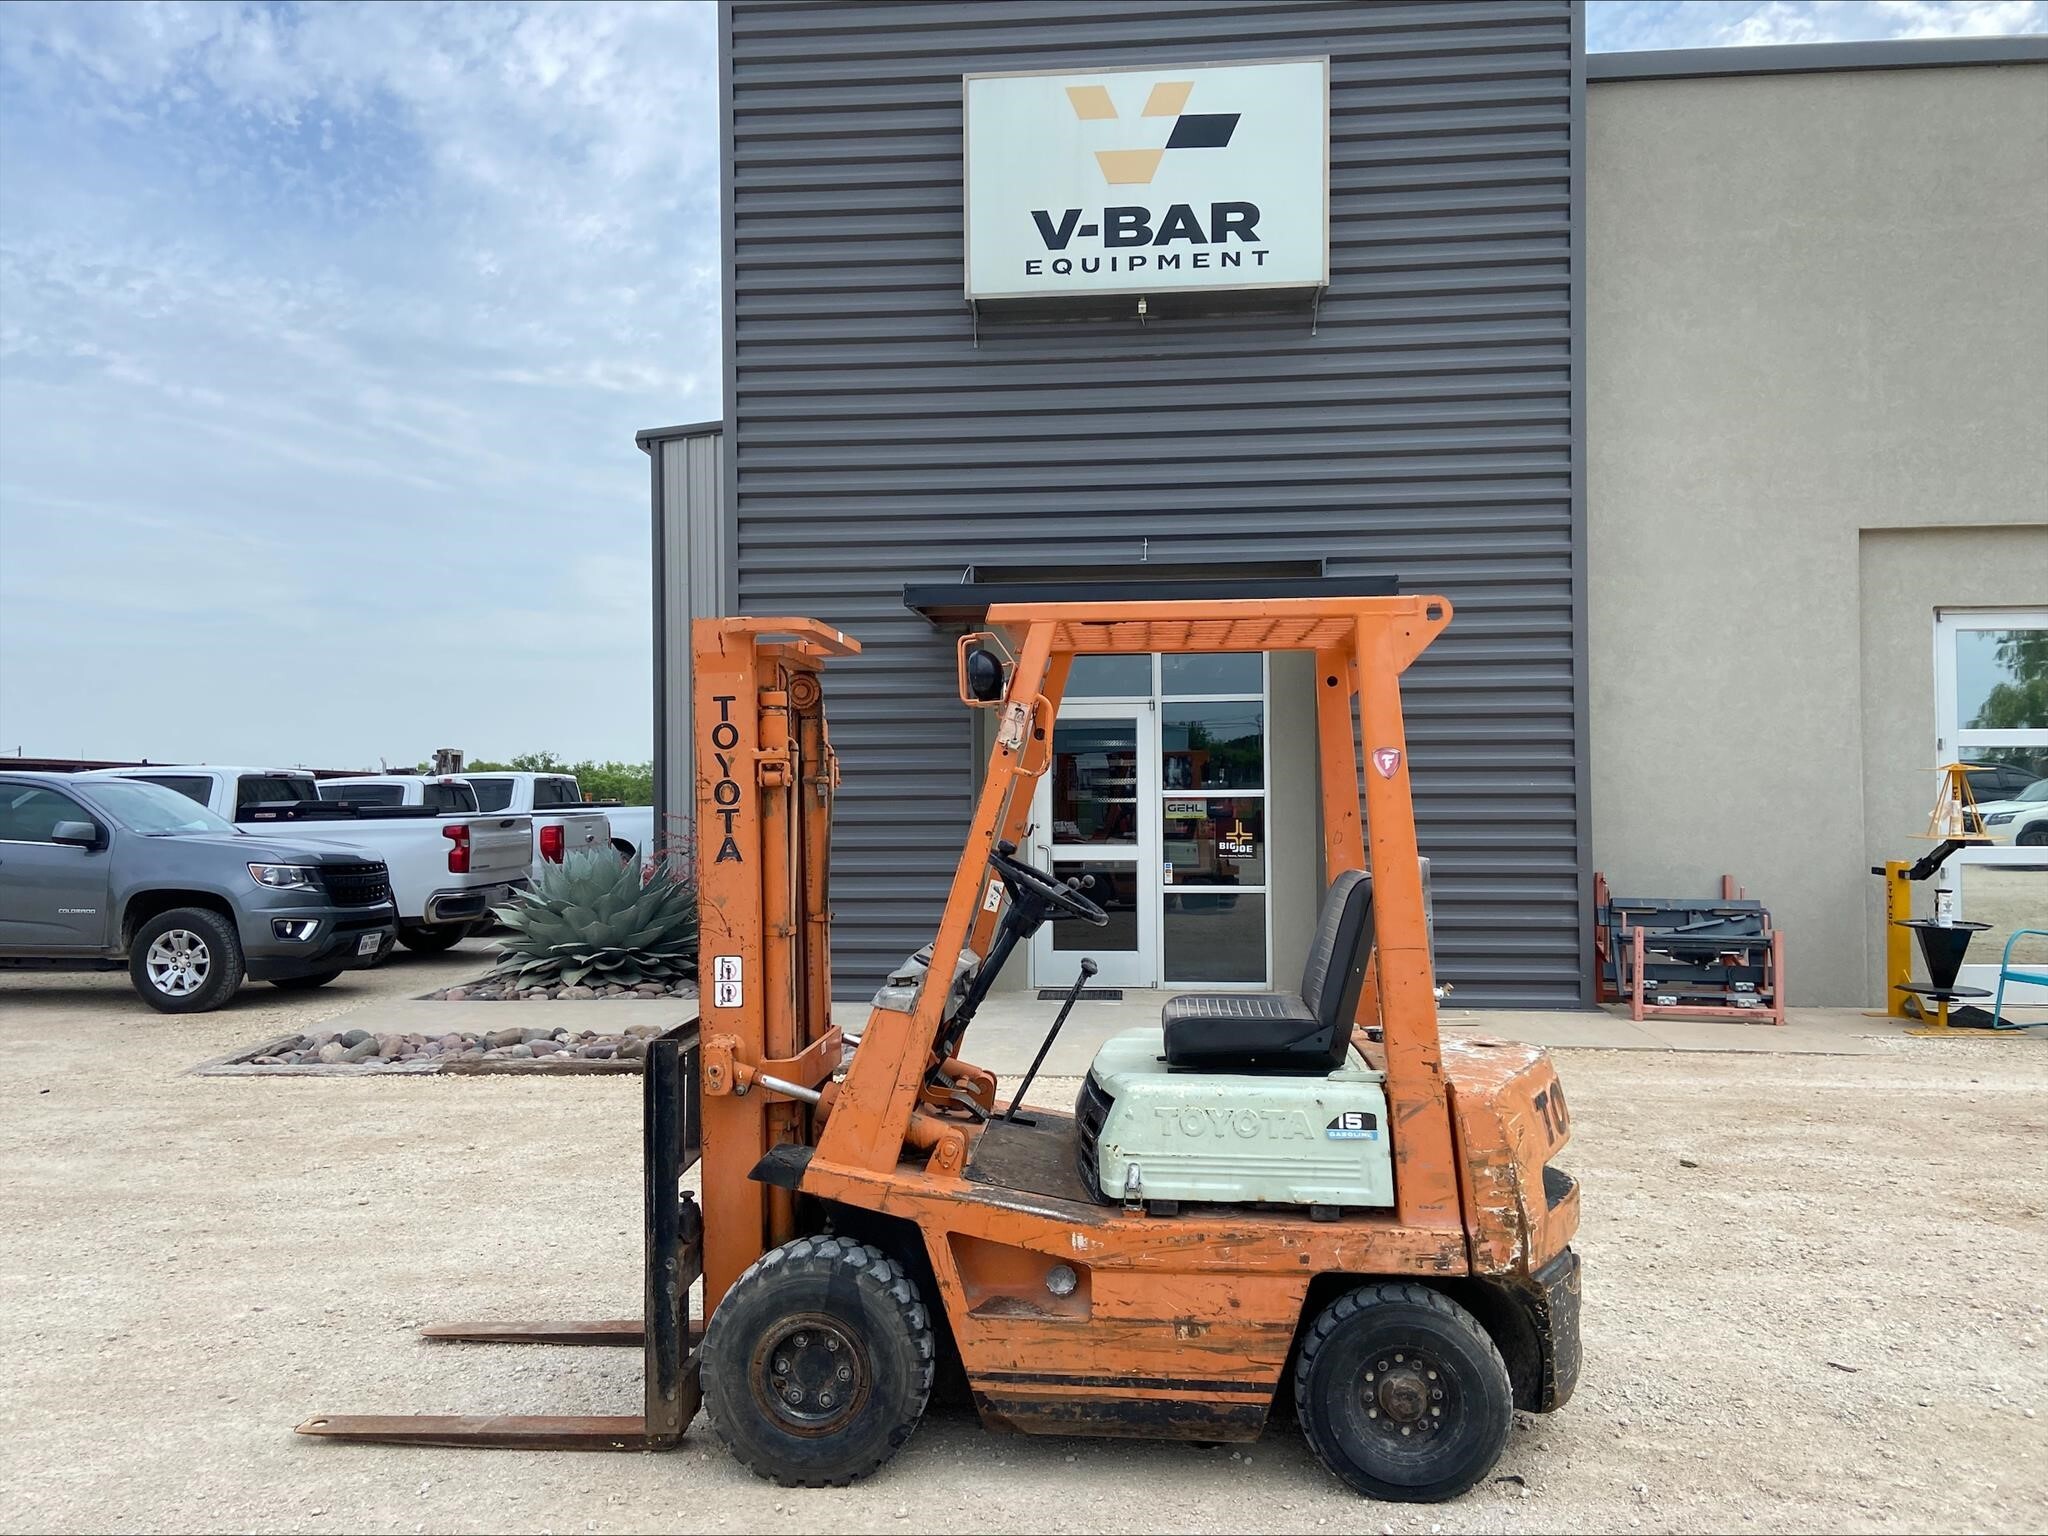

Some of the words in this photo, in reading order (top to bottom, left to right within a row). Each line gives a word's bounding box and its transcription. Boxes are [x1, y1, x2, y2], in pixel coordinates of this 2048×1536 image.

[1031, 201, 1261, 250] V-BAR
[1025, 250, 1269, 275] EQUIPMENT
[712, 695, 743, 863] TOYOTA
[1167, 803, 1203, 812] GEHL
[1219, 842, 1236, 850] BIG
[1232, 845, 1253, 853] JOE
[1154, 1106, 1314, 1140] TOYOTA
[1338, 1113, 1362, 1129] 15
